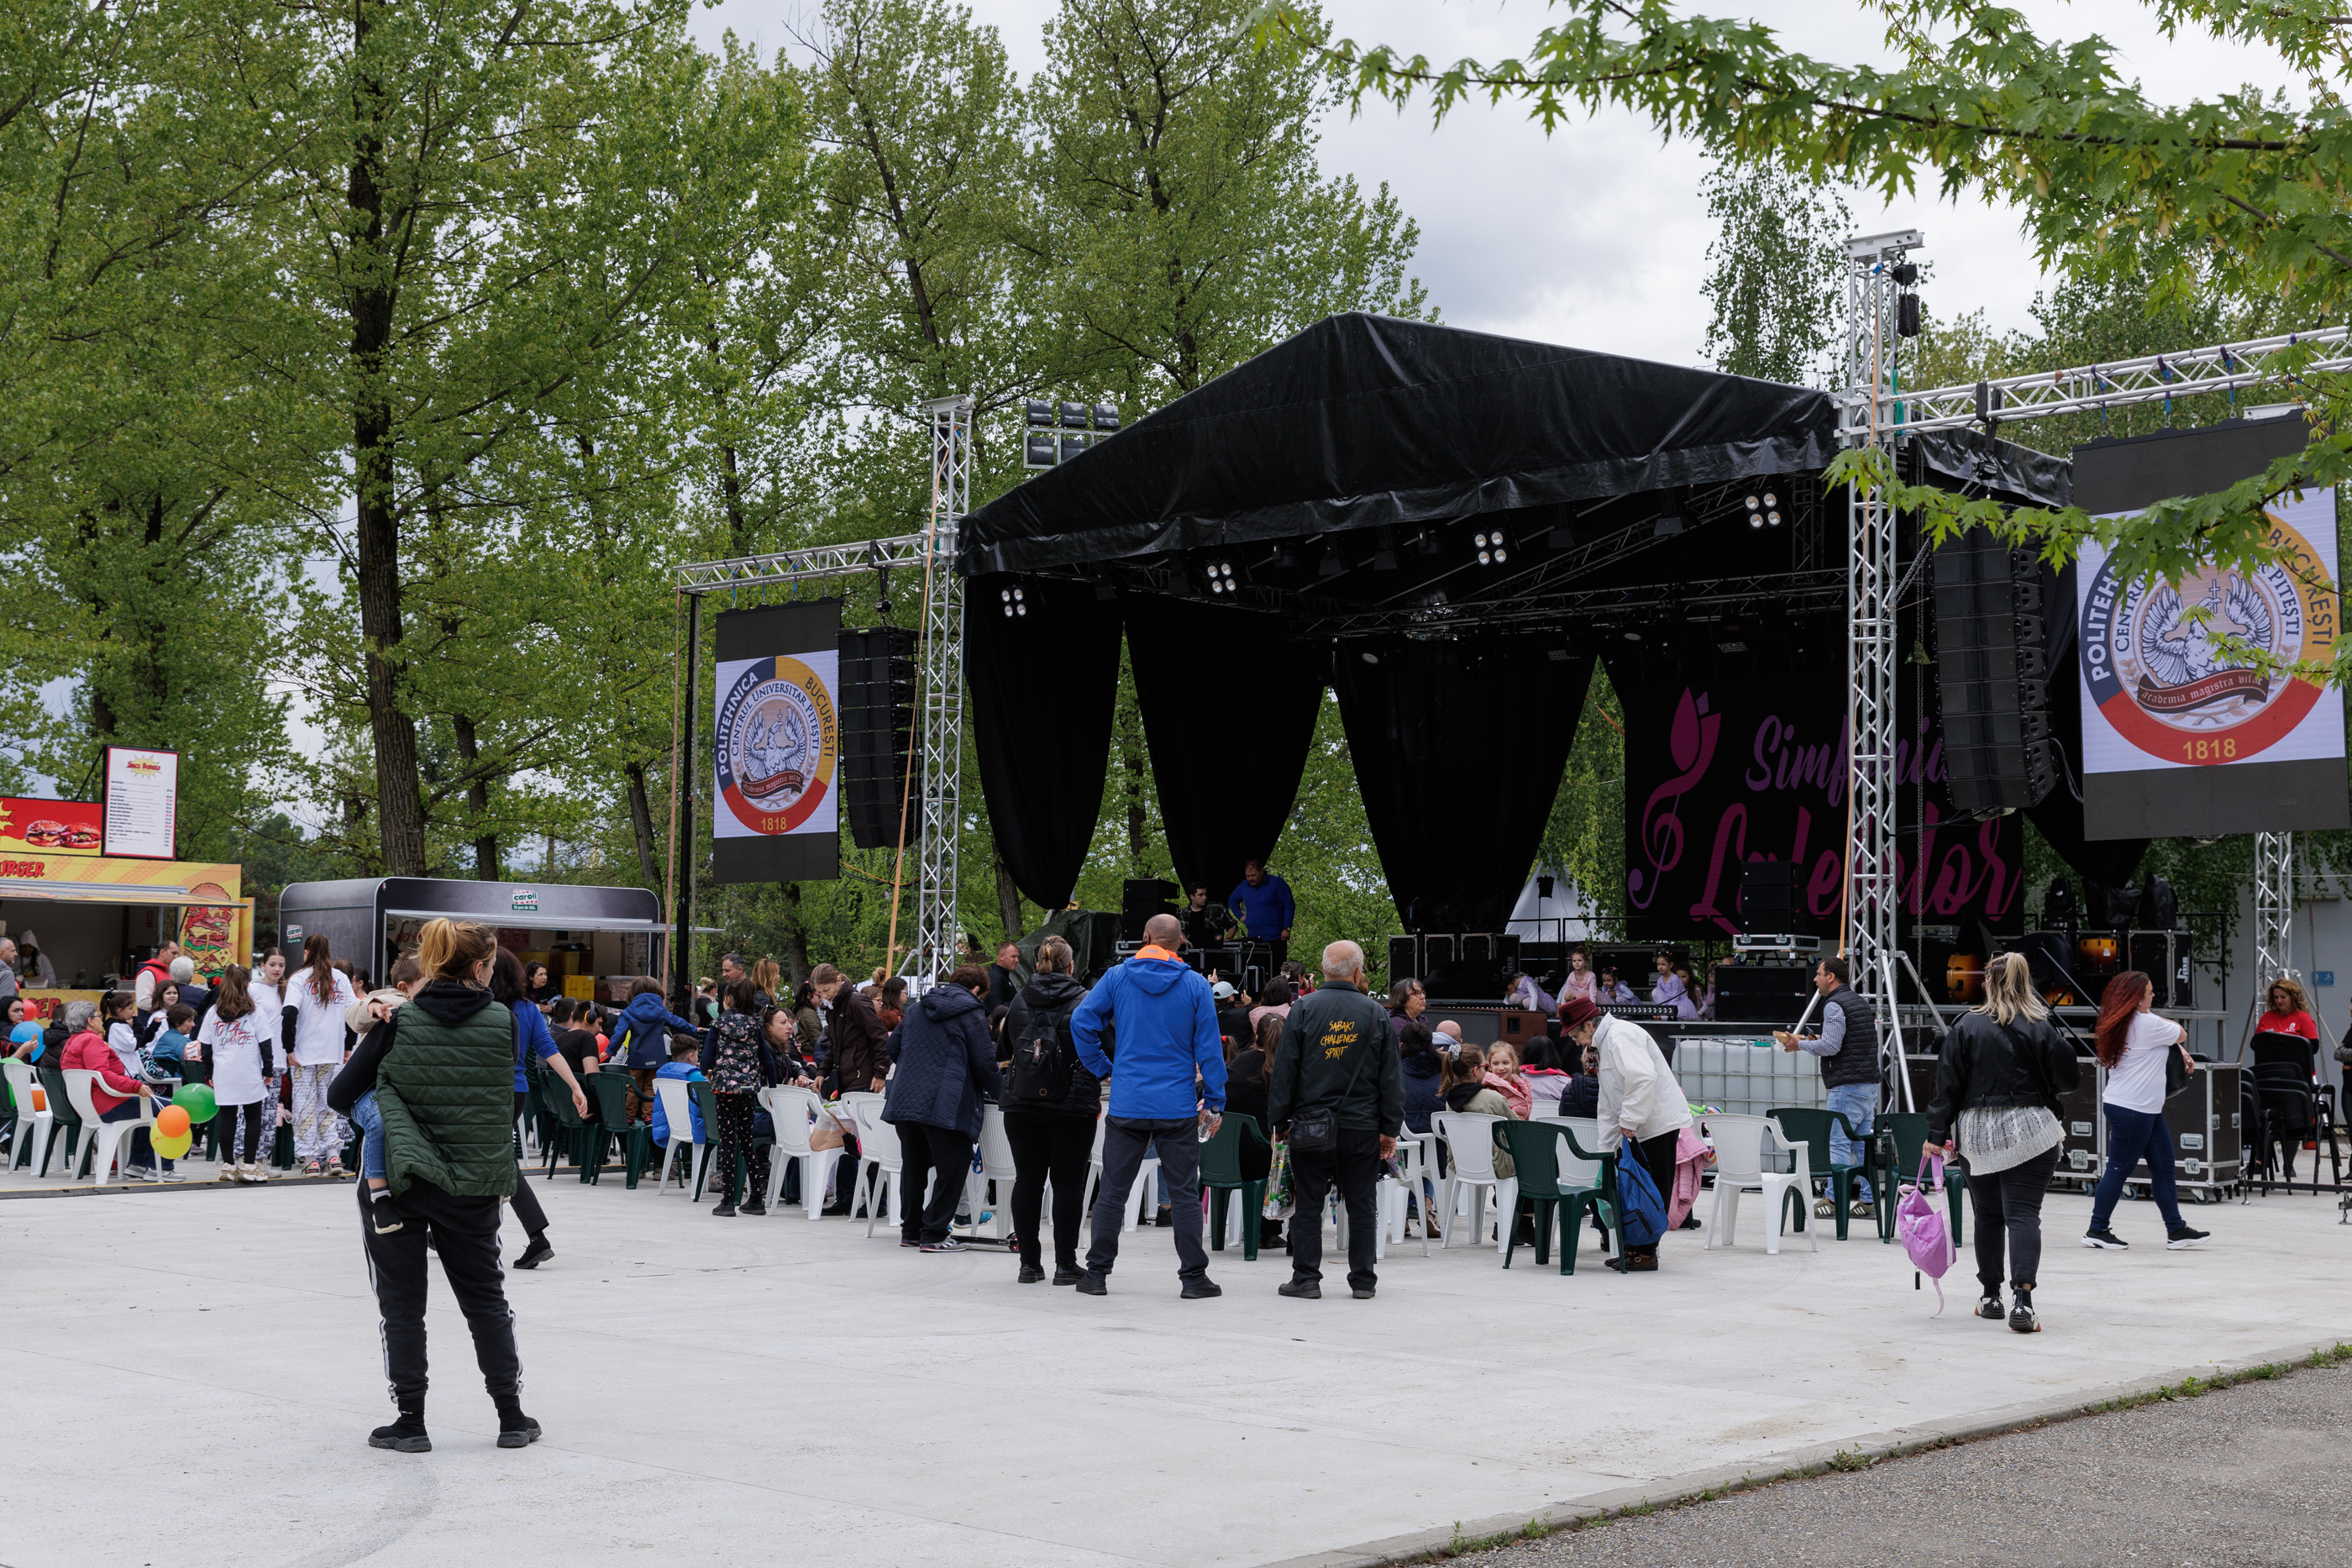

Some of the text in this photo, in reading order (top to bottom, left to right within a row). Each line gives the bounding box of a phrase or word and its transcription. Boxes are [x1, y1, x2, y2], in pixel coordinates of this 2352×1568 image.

[2268, 568, 2300, 636] PITEȘTI
[2142, 690, 2186, 704] academia
[2190, 678, 2234, 700] magistra
[718, 672, 759, 775] POLITEHNICA
[732, 684, 820, 756] CENTRUL UNIVERSITAR PITEȘTI
[806, 677, 834, 757] BUCUREȘTI
[2182, 738, 2236, 760] 1818
[762, 817, 787, 831] 1818
[213, 1020, 250, 1037] TOTAL
[1329, 1020, 1355, 1032] SABAKI
[218, 1035, 254, 1047] DANCE
[1320, 1034, 1359, 1047] CHALLENGE
[1325, 1046, 1348, 1061] SPIRIT
